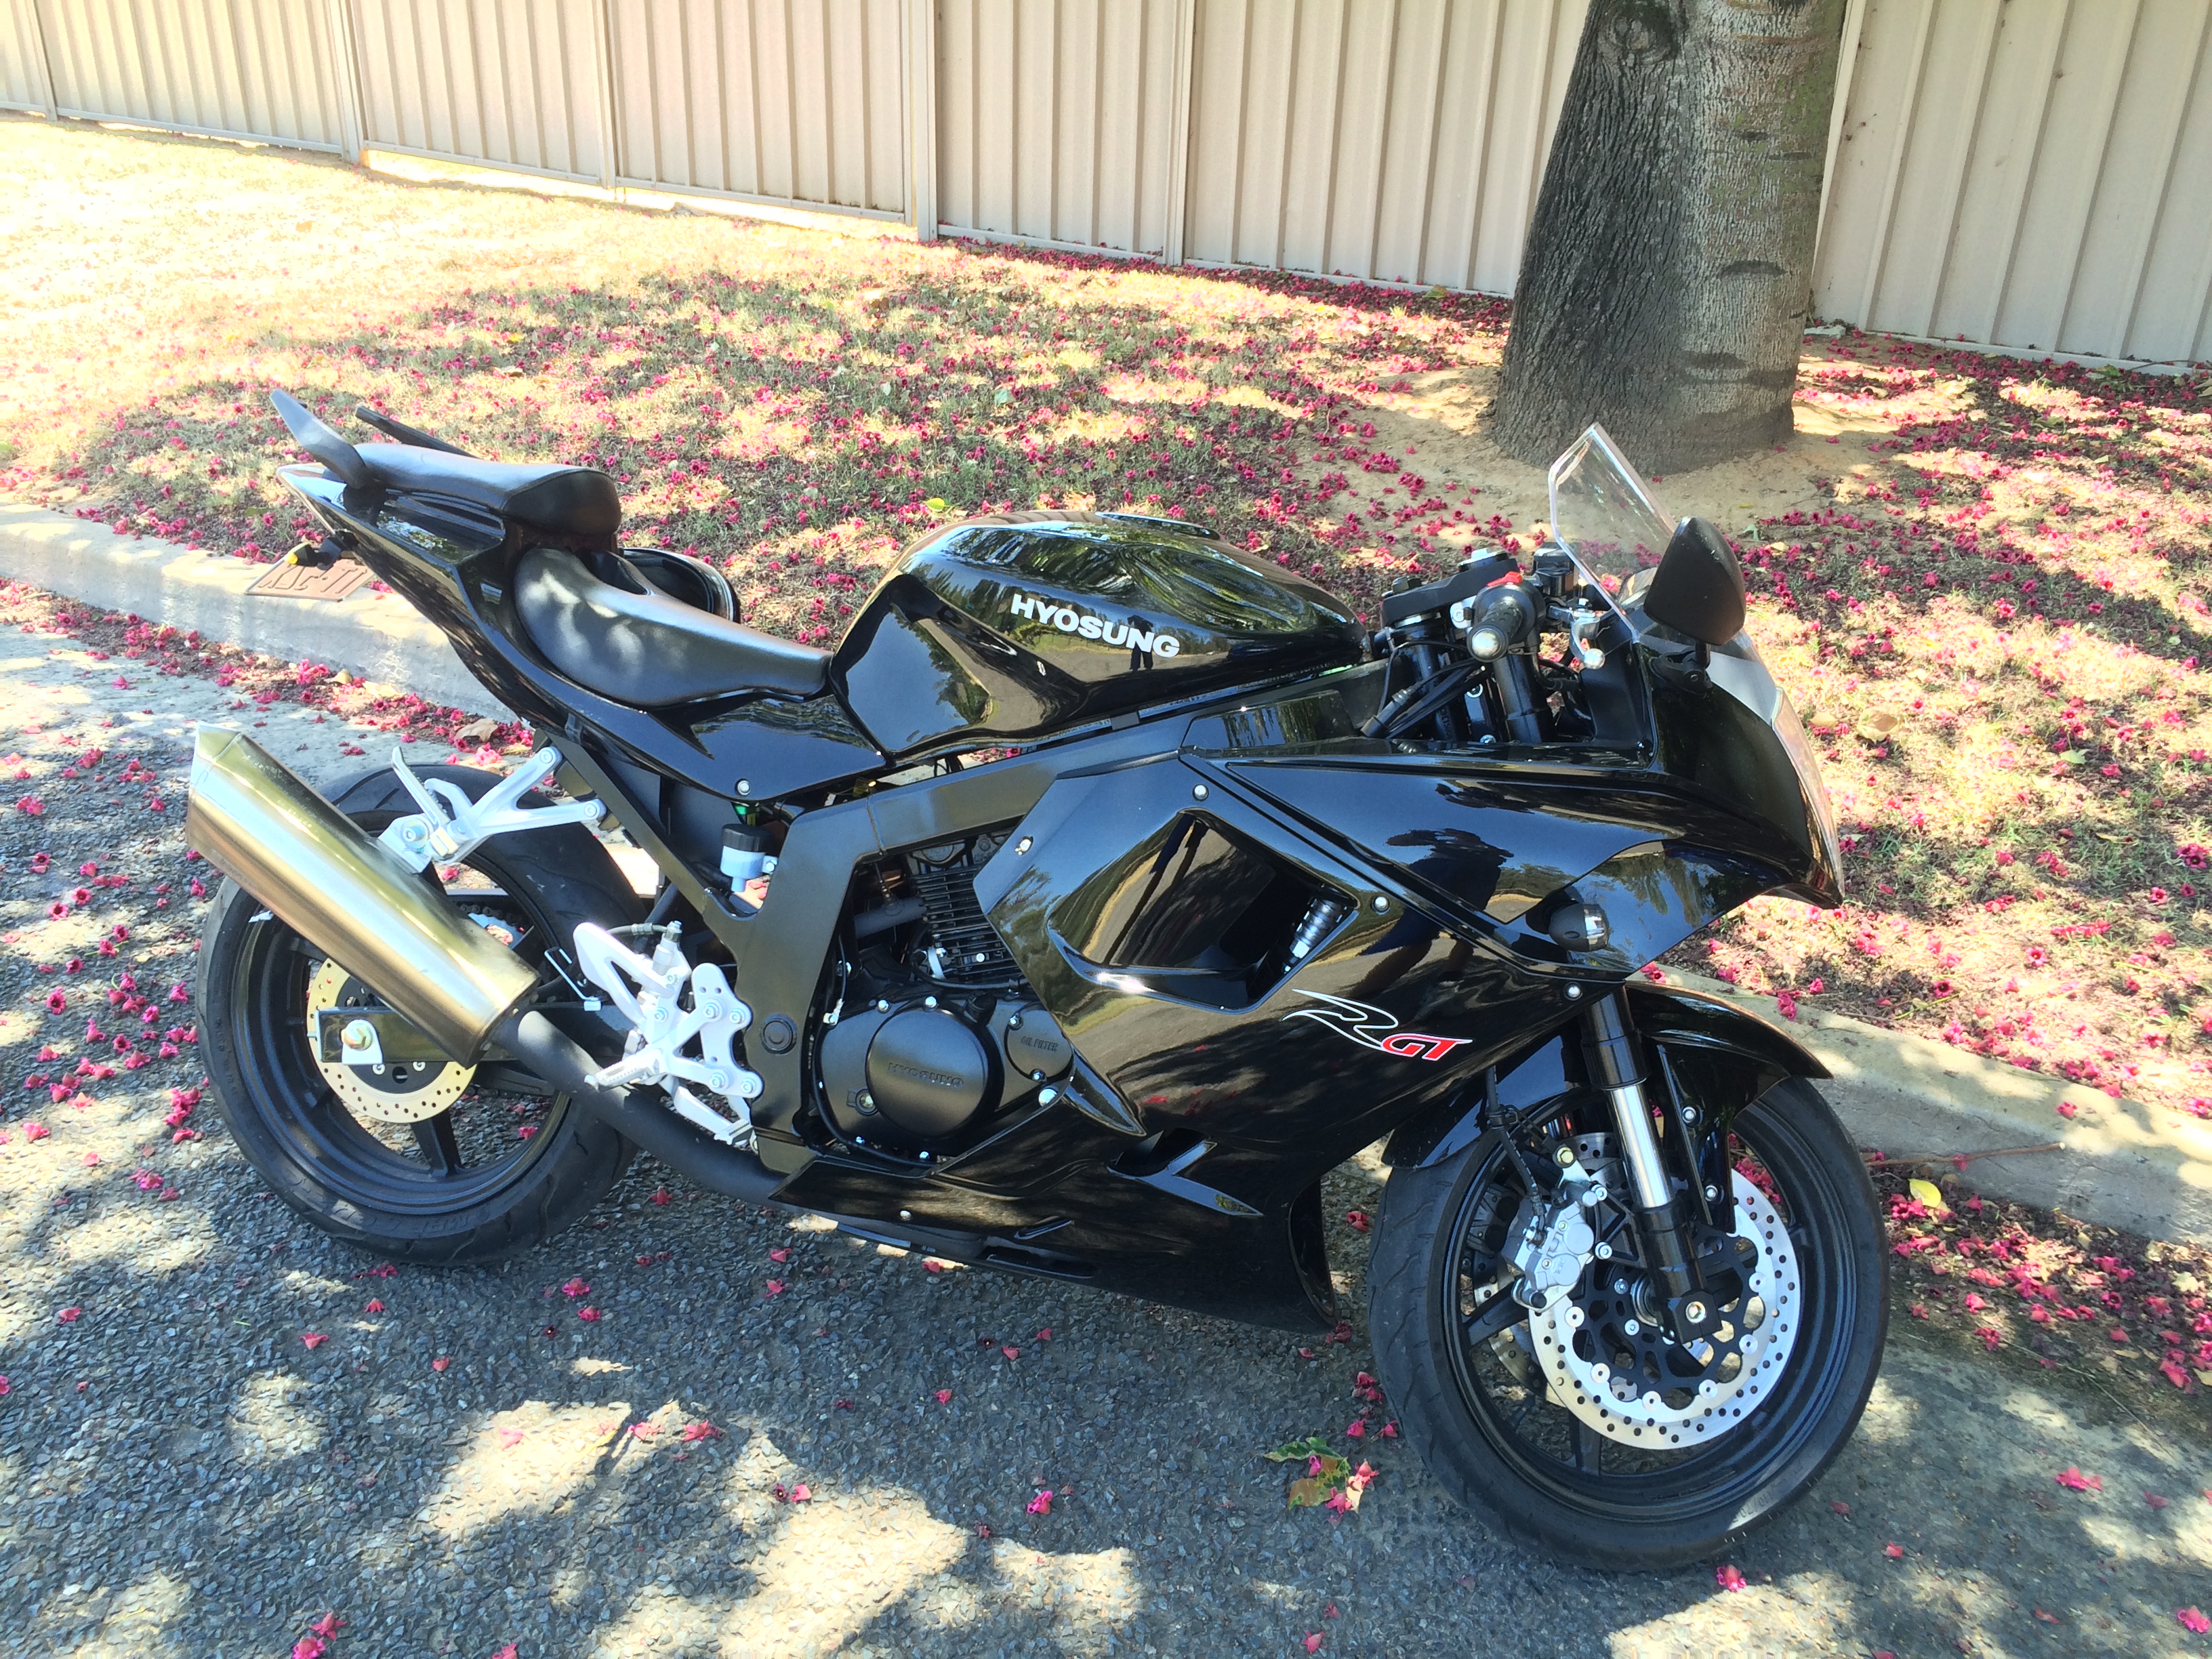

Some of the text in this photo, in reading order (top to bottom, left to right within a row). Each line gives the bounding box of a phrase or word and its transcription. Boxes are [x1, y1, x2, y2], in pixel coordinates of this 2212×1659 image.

[1010, 594, 1180, 657] HYOSUNG
[1021, 1036, 1059, 1052] OIL FILTER
[888, 1062, 964, 1089] HYOSUNG
